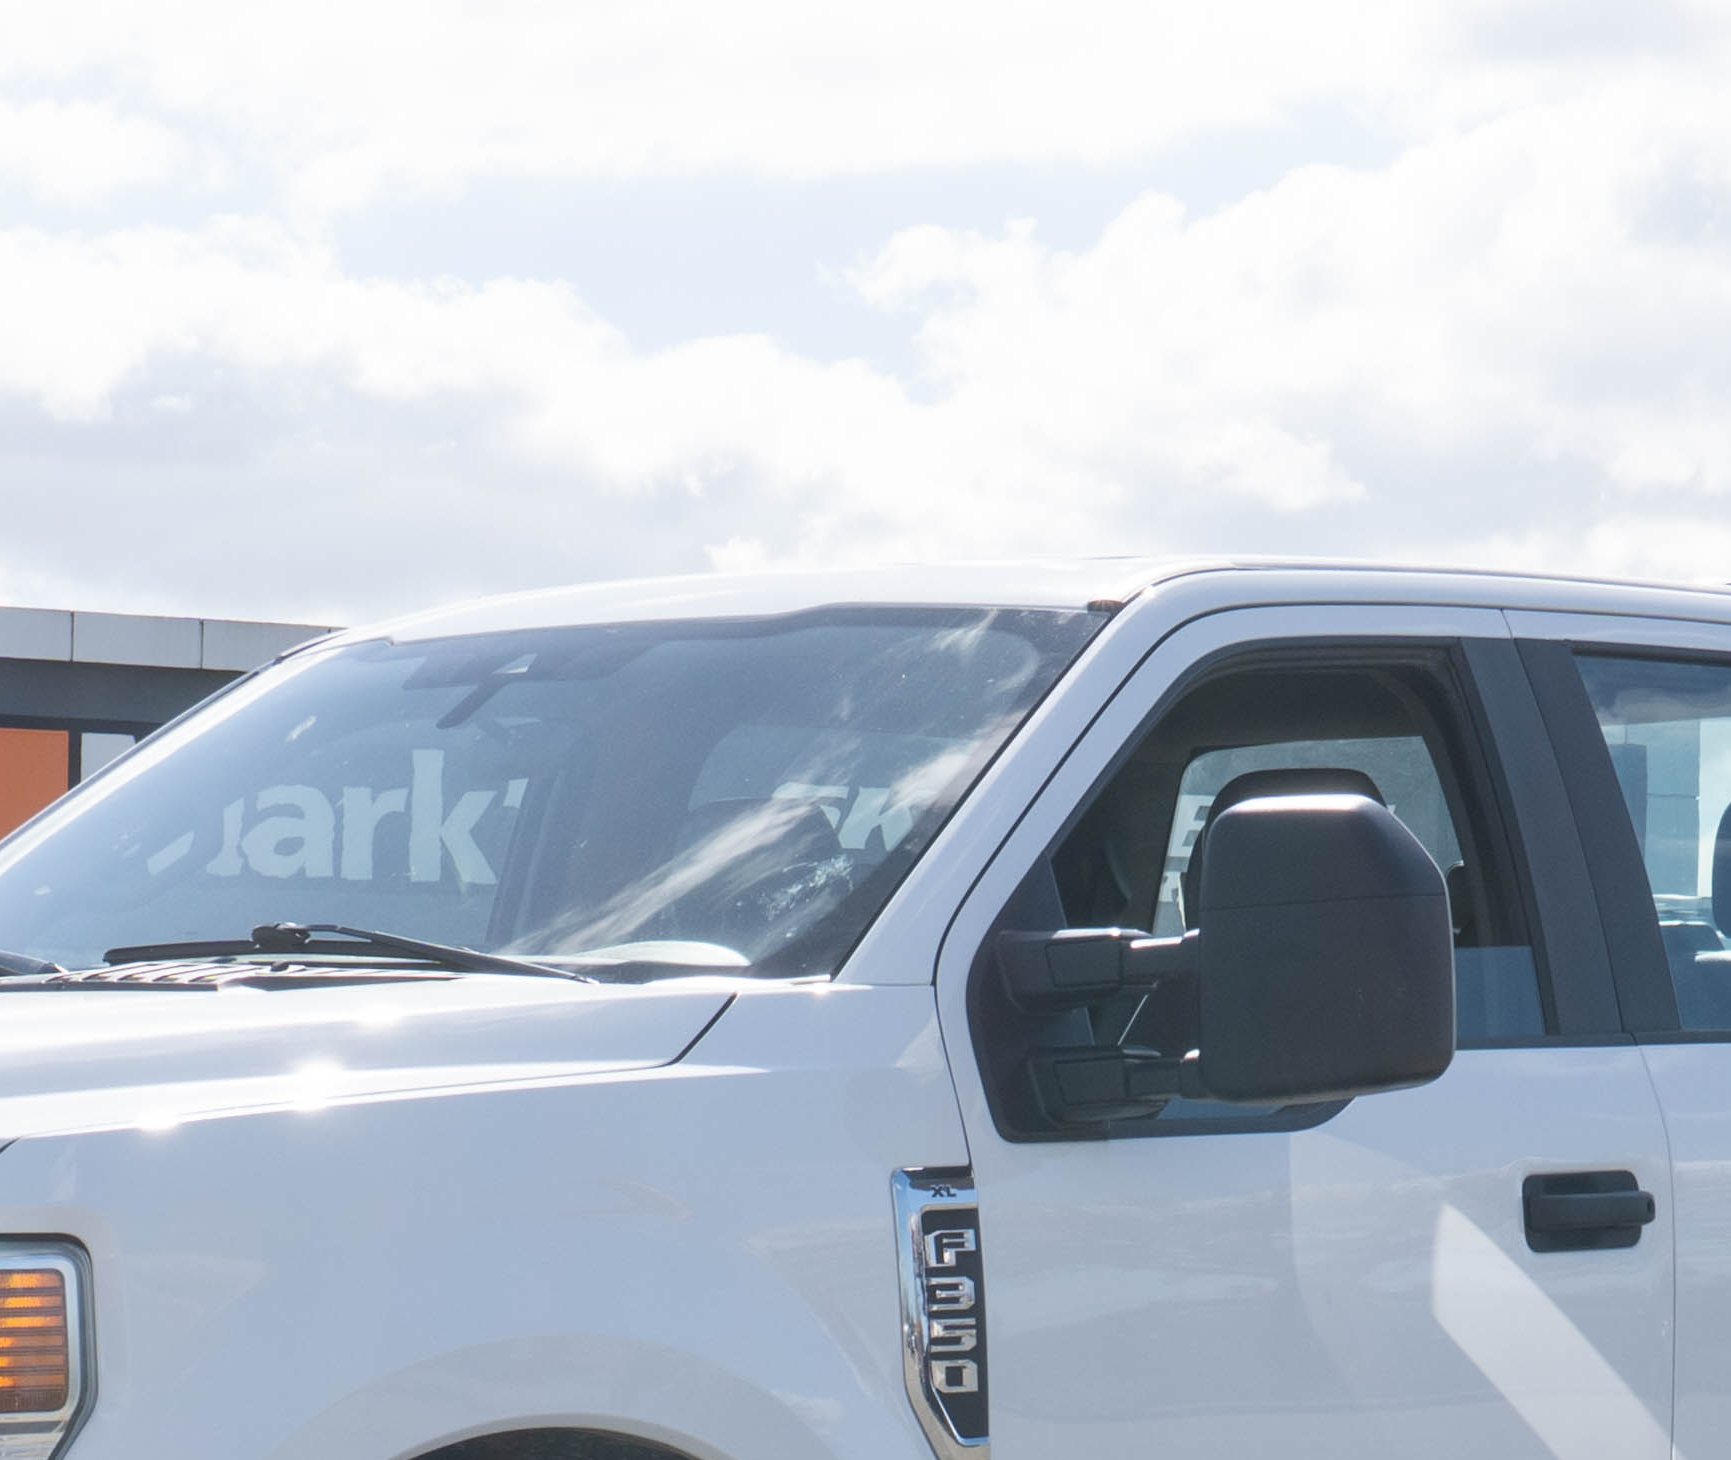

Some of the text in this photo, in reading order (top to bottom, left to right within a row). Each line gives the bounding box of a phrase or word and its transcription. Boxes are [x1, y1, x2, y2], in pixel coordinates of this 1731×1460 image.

[147, 748, 528, 885] ark'
[930, 1184, 957, 1199] XL
[923, 1228, 979, 1394] F350
